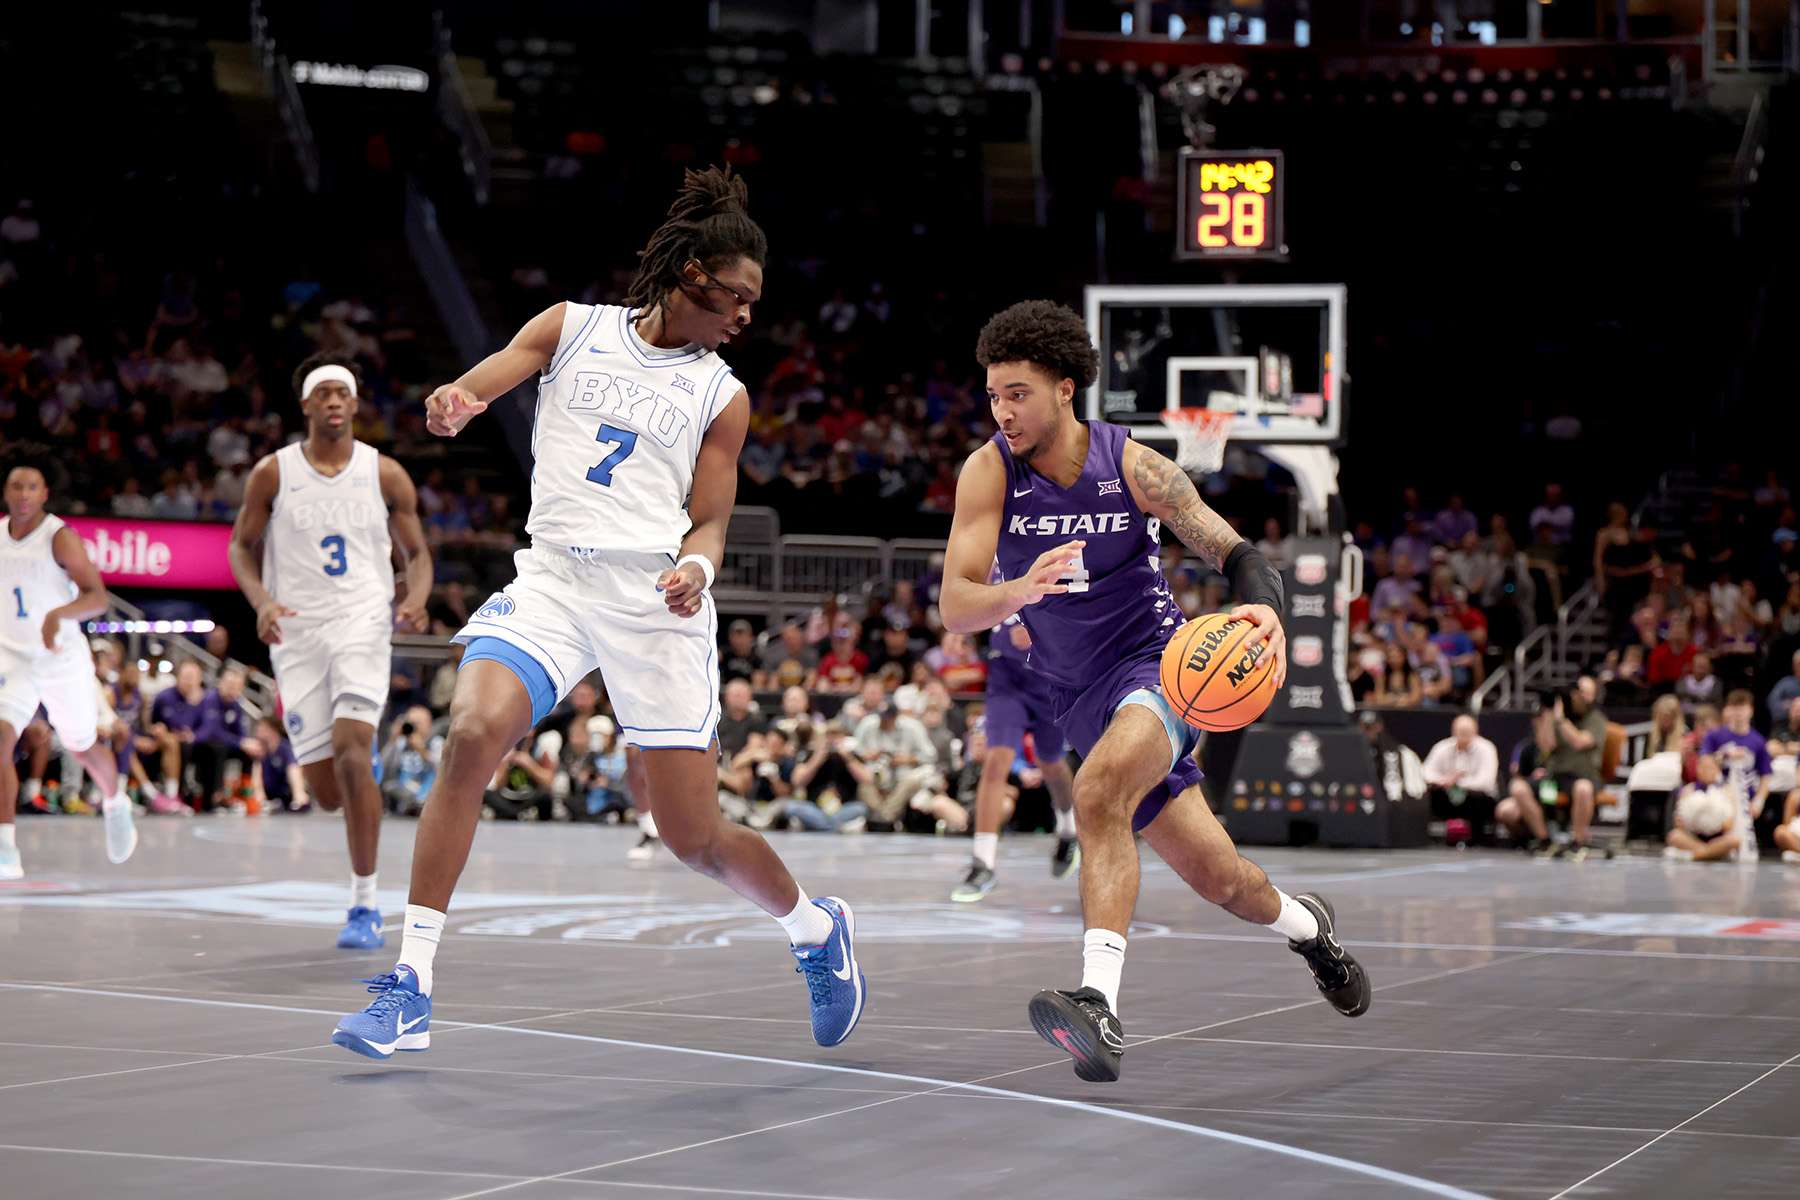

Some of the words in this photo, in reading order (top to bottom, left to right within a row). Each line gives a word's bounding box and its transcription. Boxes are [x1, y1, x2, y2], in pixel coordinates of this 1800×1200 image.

[1198, 192, 1265, 247] 28
[568, 371, 690, 448] BYU
[585, 423, 639, 487] 7
[291, 498, 370, 532] BYU
[1008, 512, 1130, 536] K-STATE
[320, 534, 348, 576] 3
[13, 586, 28, 617] 1
